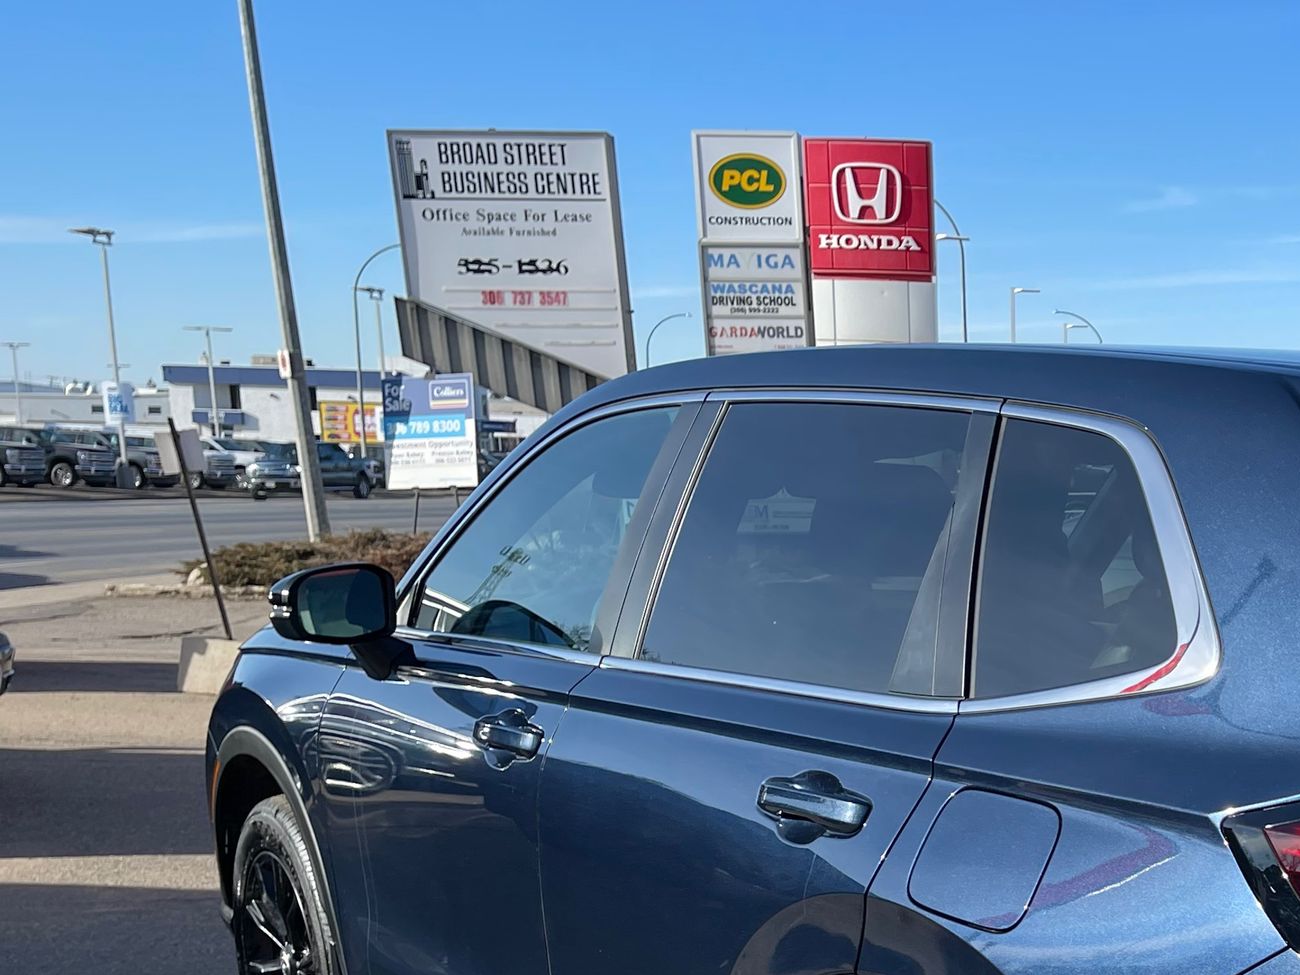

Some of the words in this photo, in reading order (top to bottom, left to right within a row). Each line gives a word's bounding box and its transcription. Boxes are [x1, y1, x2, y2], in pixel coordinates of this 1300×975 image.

[437, 141, 498, 165] BROAD
[503, 142, 567, 166] STREET
[441, 171, 529, 195] BUSINESS
[534, 172, 602, 196] CENTRE
[721, 168, 775, 192] PCL
[421, 207, 470, 223] Office
[476, 208, 517, 225] Space
[524, 209, 547, 223] For
[553, 209, 593, 223] Lease
[708, 215, 793, 227] CONSTRUCTION
[818, 233, 922, 251] HONDA
[711, 283, 796, 295] WASCANA
[711, 295, 753, 307] DRIVING
[755, 296, 797, 307] SCHOOL
[384, 397, 411, 412] Sale
[432, 419, 461, 434] 8300
